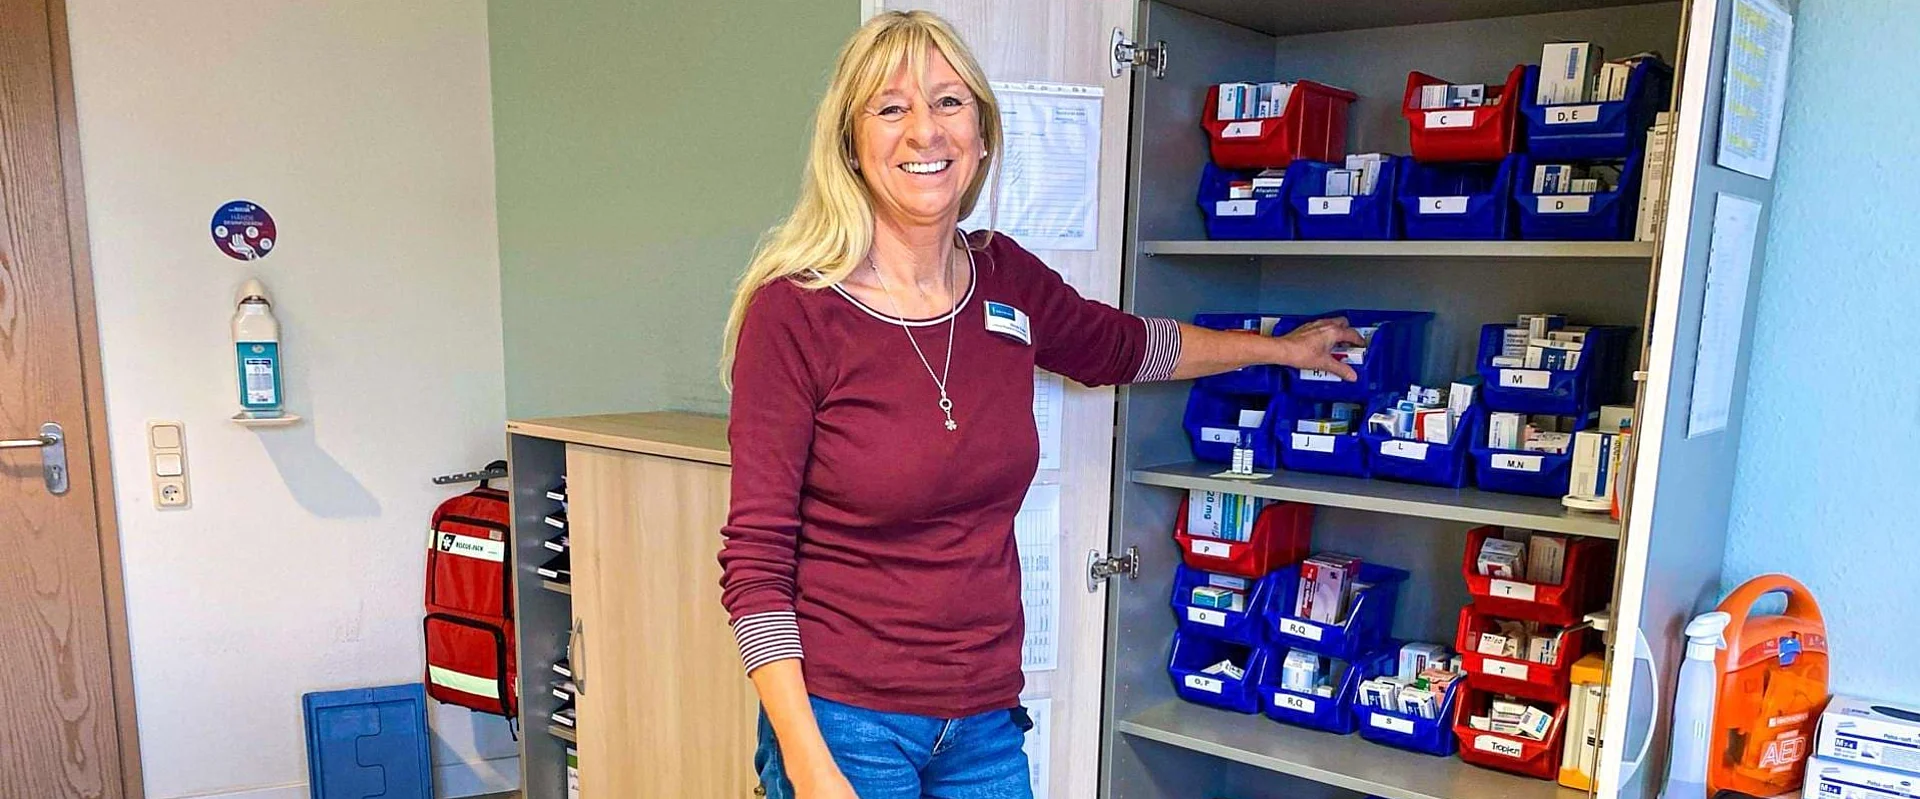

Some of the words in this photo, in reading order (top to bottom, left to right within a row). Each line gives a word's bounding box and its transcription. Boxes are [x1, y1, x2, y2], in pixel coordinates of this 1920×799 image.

[1440, 115, 1447, 125] C
[1557, 112, 1569, 123] D,
[1571, 110, 1578, 120] E
[1323, 201, 1329, 209] B
[1434, 200, 1442, 209] C
[1555, 200, 1564, 210] D
[1512, 374, 1523, 384] M
[1305, 435, 1310, 447] J
[1398, 442, 1403, 450] L
[1206, 490, 1215, 503] 20
[1203, 505, 1213, 520] mg
[1505, 586, 1512, 595] T
[1199, 612, 1207, 621] O
[1289, 623, 1306, 635] R,Q
[1499, 666, 1506, 674] T
[1386, 717, 1392, 725] S
[1835, 738, 1844, 748] M
[1758, 736, 1807, 769] AED
[1820, 784, 1829, 793] M
